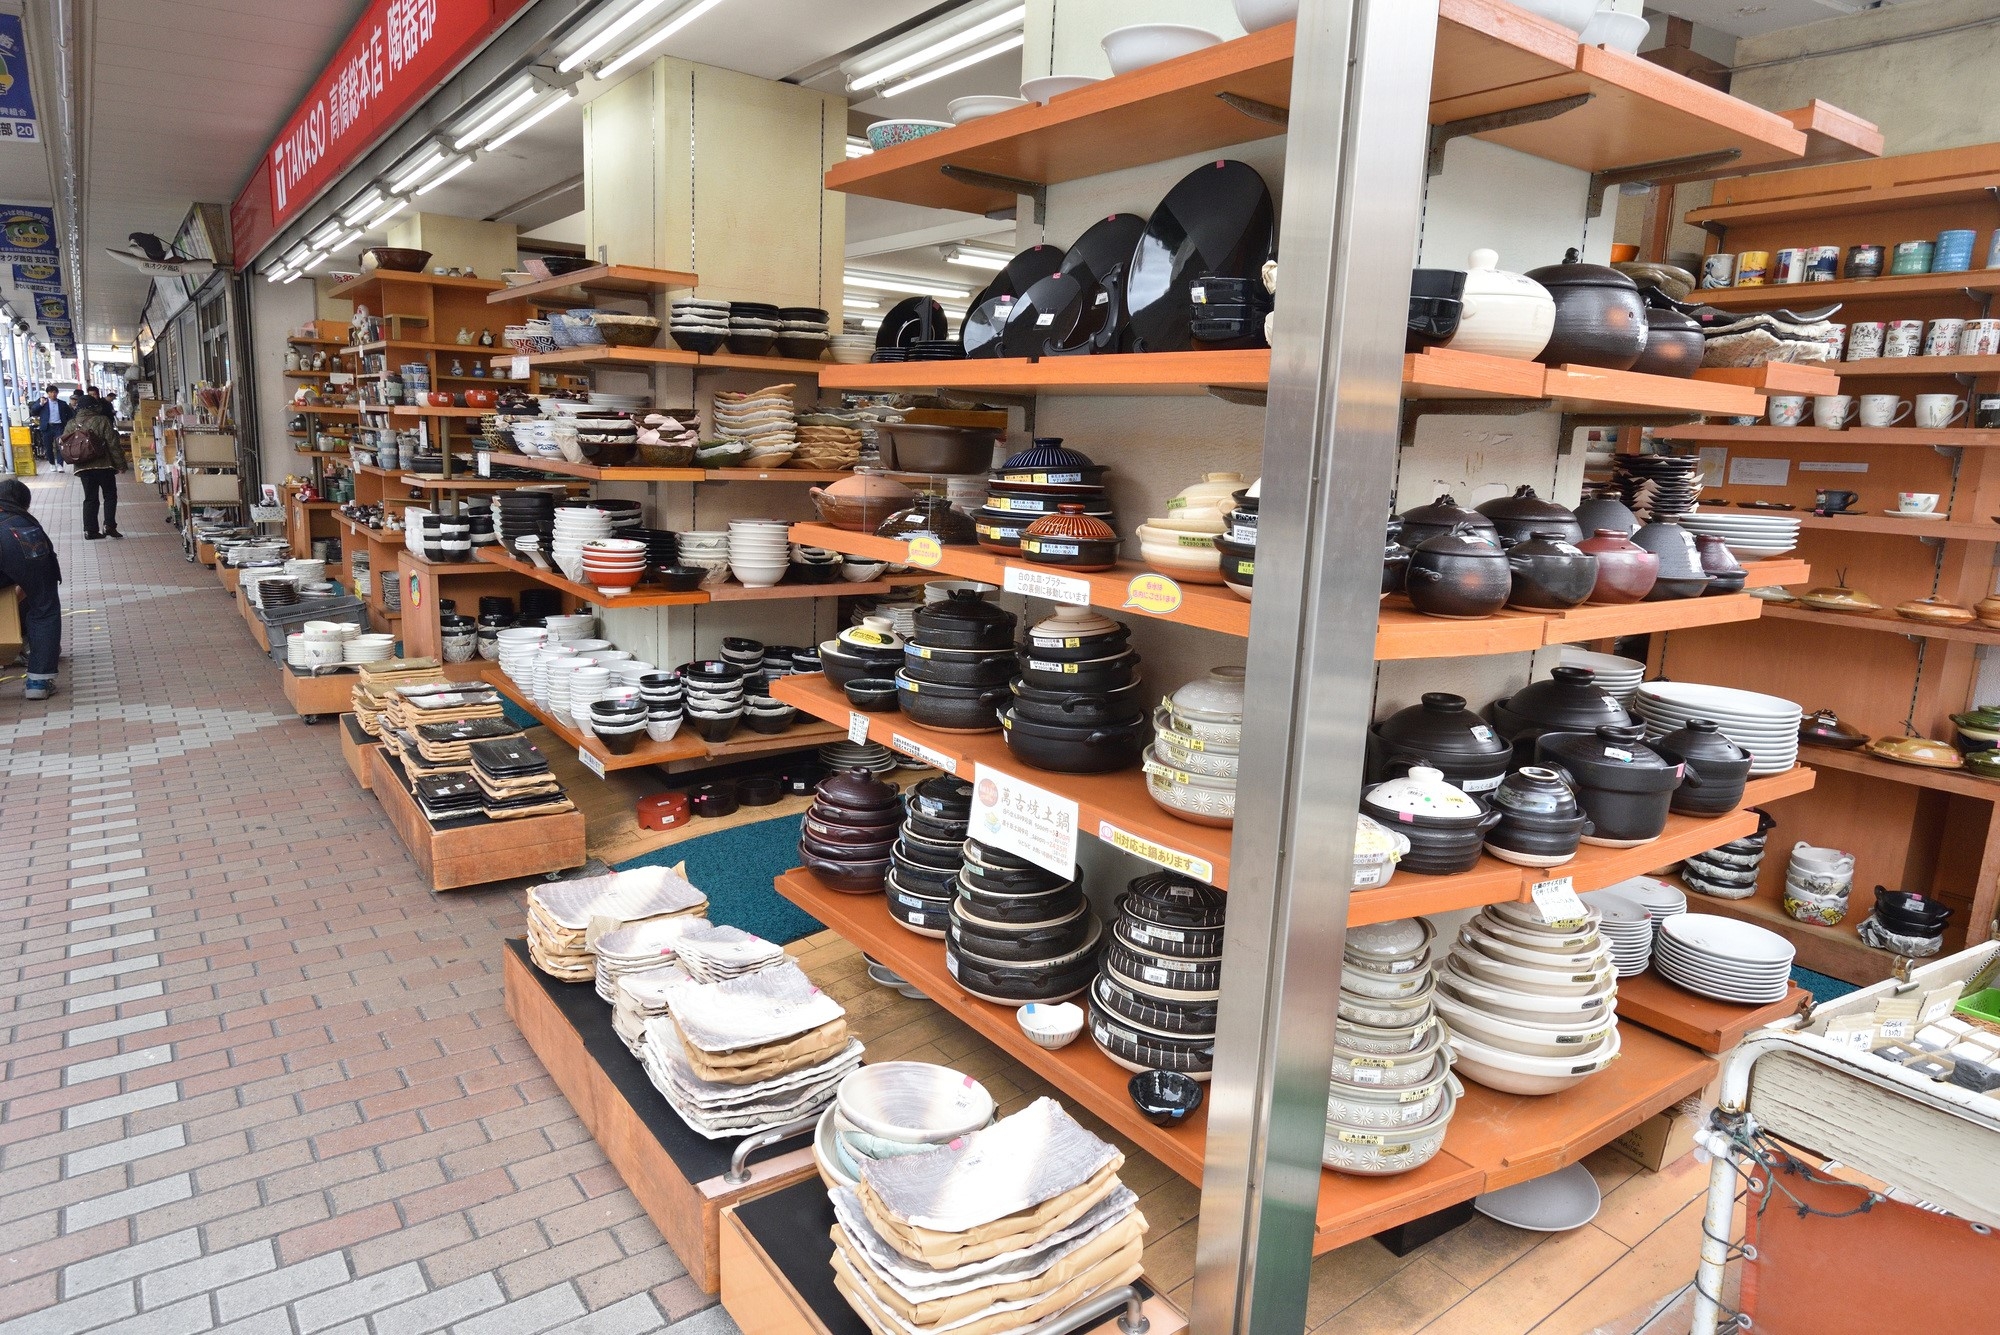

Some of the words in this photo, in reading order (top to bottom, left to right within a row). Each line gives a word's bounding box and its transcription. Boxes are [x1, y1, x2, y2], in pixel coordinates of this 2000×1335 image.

[285, 100, 326, 189] TAKASO
[329, 25, 384, 146] 高橋総本店
[386, 0, 437, 81] 陶器部
[17, 126, 33, 136] 20
[1001, 787, 1071, 833] 萬古焼土鍋
[1113, 831, 1193, 871] IH対応土鍋あります
